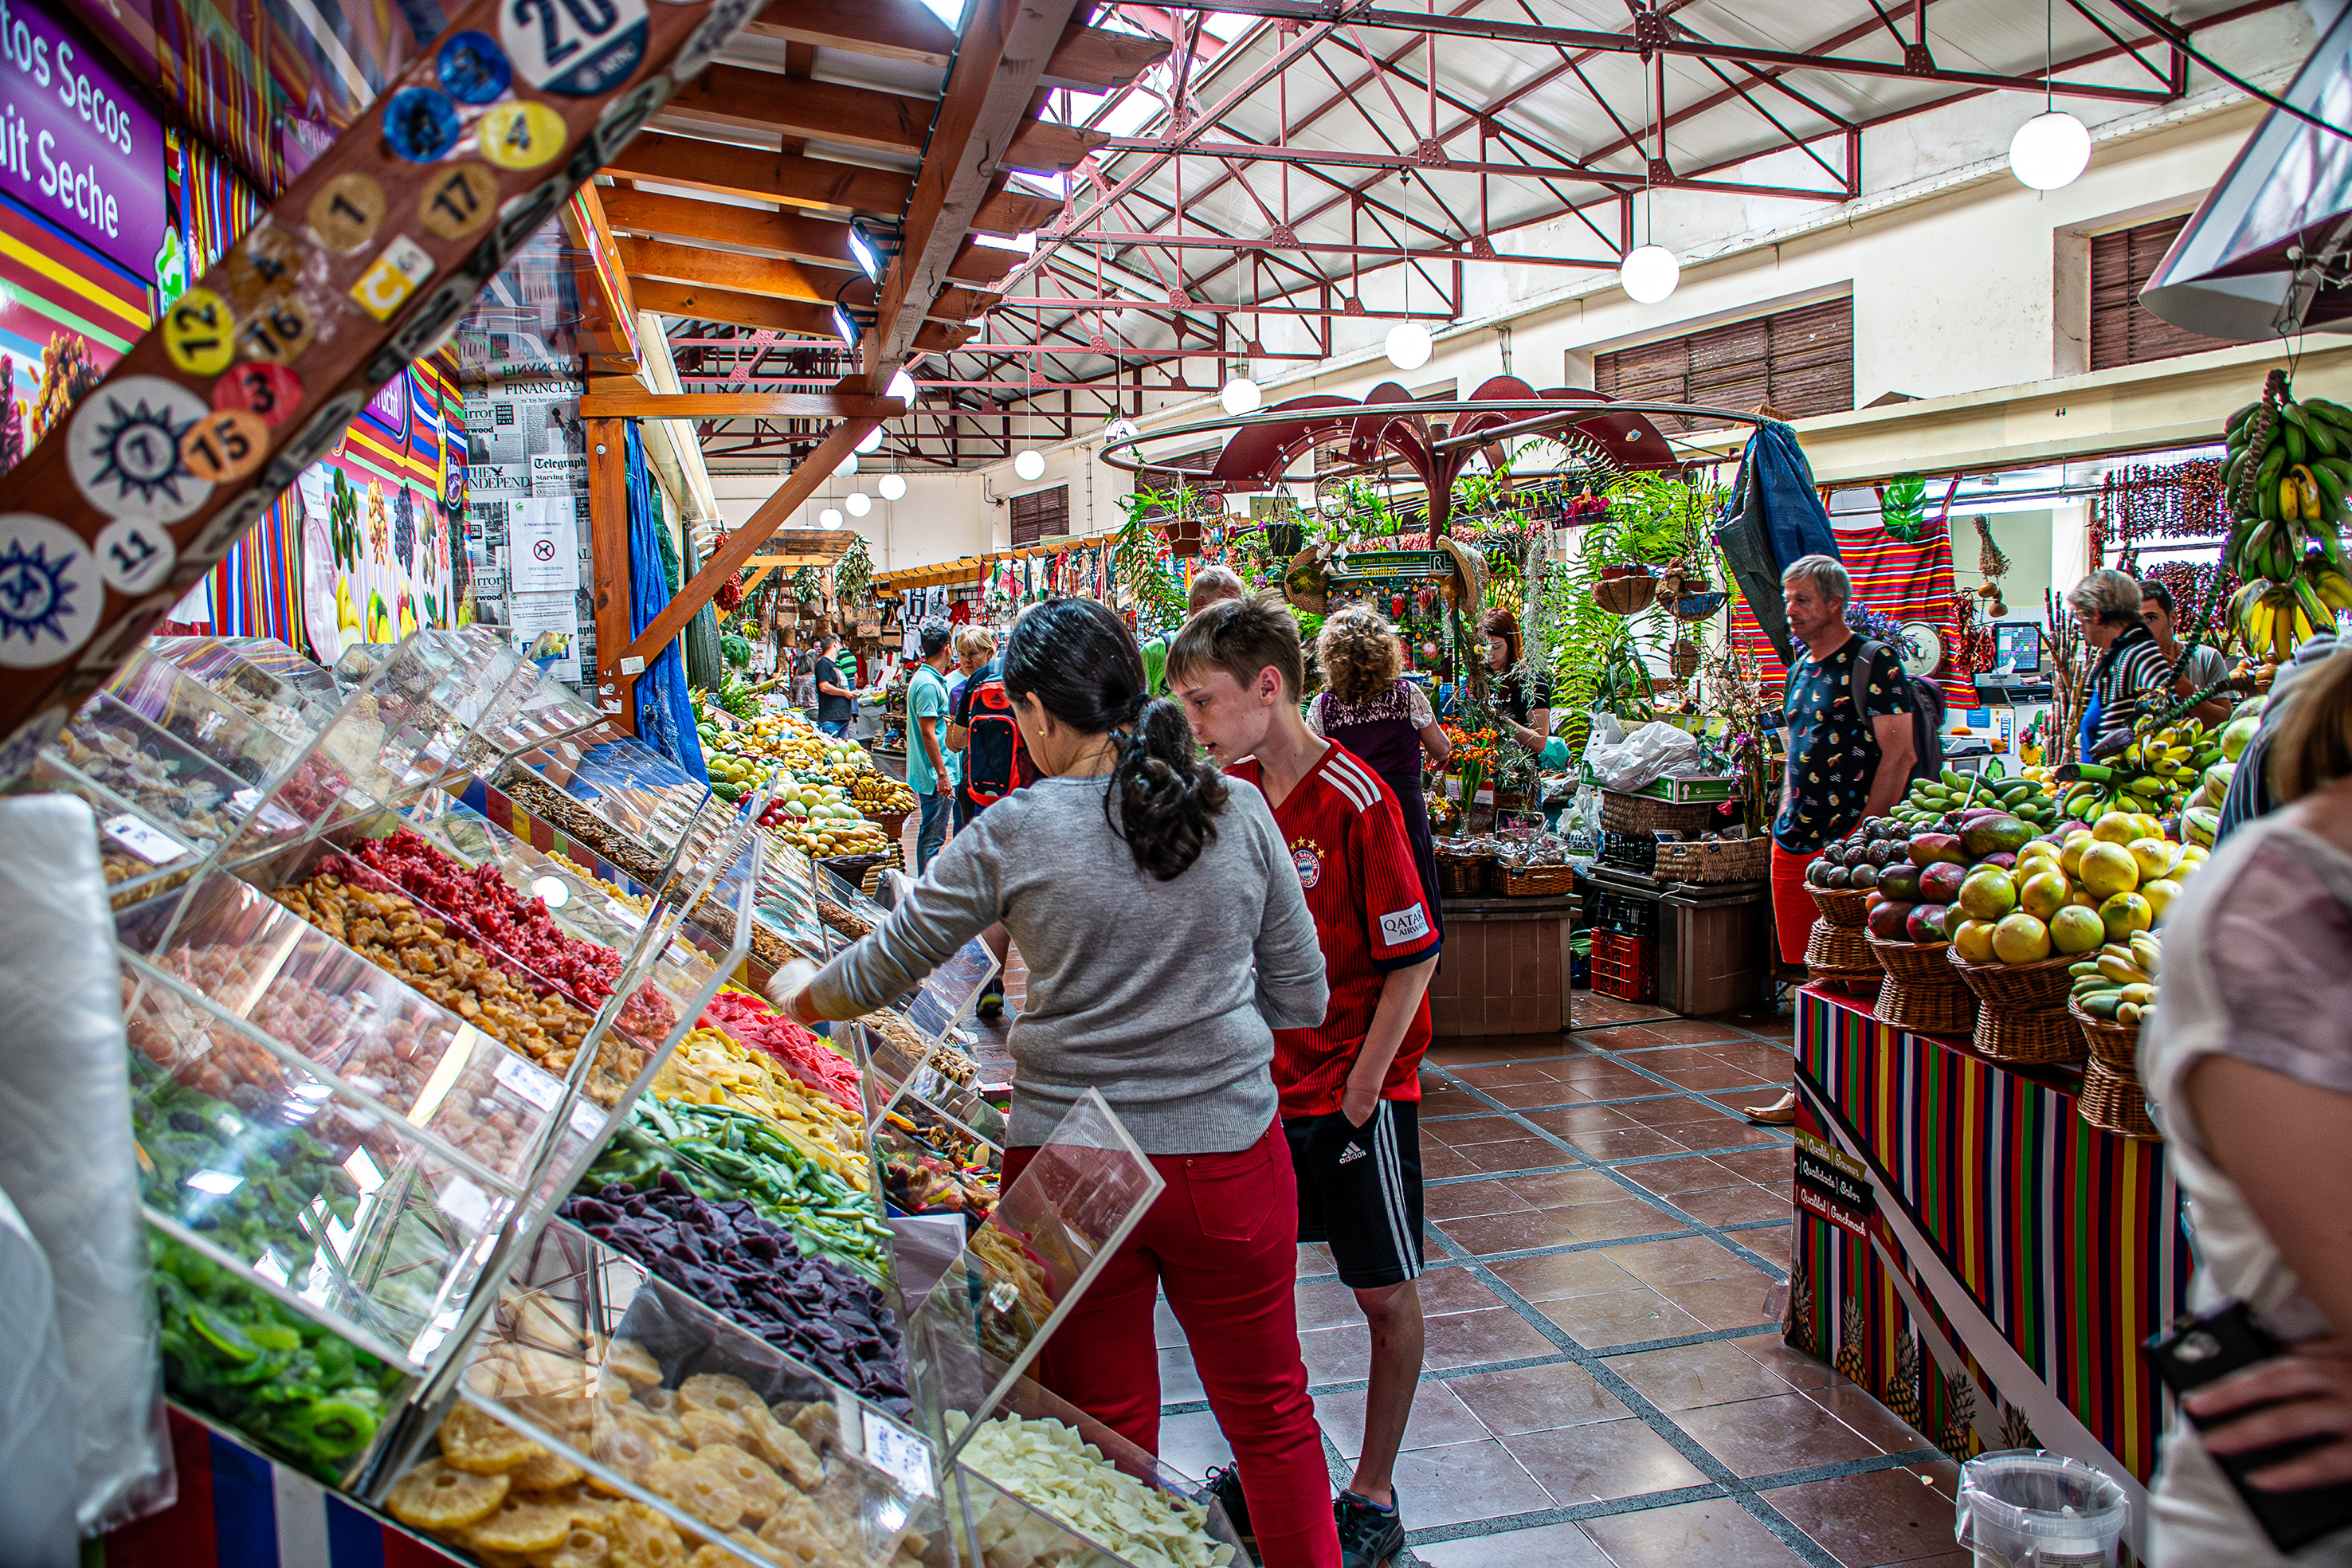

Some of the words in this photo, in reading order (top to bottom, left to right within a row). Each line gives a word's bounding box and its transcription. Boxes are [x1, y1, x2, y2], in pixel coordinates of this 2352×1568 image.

[57, 40, 131, 155] Secos
[38, 128, 119, 239] Seche
[430, 171, 477, 223] 17
[329, 193, 367, 224] 1
[366, 267, 404, 308] C
[174, 304, 220, 363] 12
[242, 306, 304, 355] 16
[245, 372, 274, 414] 3
[504, 382, 582, 394] FINANCIAL
[127, 433, 155, 466] 7
[188, 417, 249, 472] 15
[468, 466, 492, 478] THE
[534, 457, 588, 470] Telegraph
[108, 528, 159, 573] 11
[1361, 566, 1399, 577] Semillas
[1299, 852, 1319, 869] BAYERN
[1383, 909, 1424, 933] QATAR
[1339, 1150, 1366, 1164] adidas
[1802, 1160, 1836, 1189] Qualidade
[1839, 1181, 1861, 1204] Sabor
[1830, 1205, 1867, 1237] Geschmack
